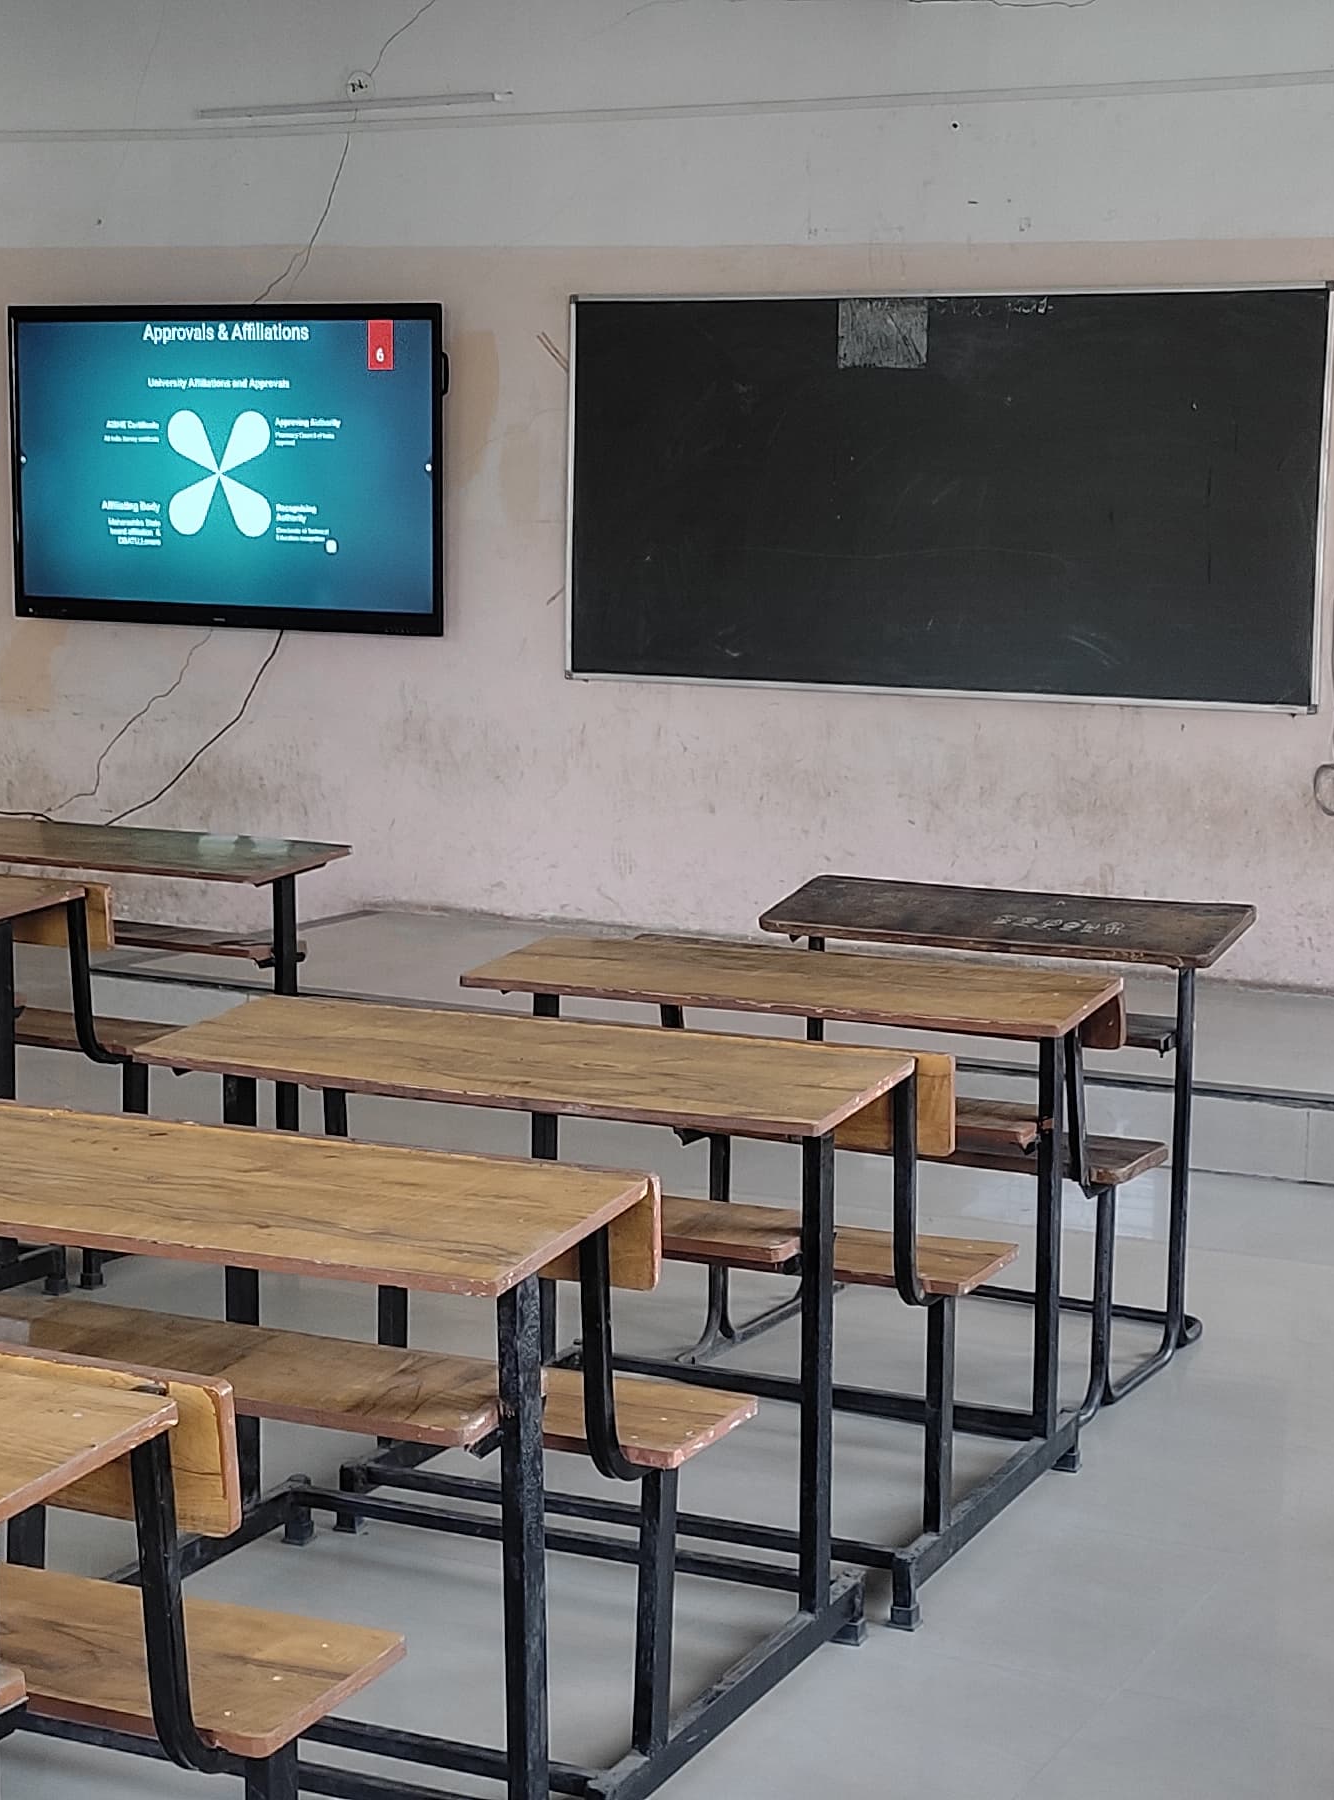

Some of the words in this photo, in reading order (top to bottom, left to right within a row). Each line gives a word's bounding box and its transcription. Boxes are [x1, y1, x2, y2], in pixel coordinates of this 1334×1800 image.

[143, 323, 215, 345] Approvals
[217, 323, 229, 341] &
[231, 322, 310, 341] Affiliations
[376, 347, 385, 363] 6
